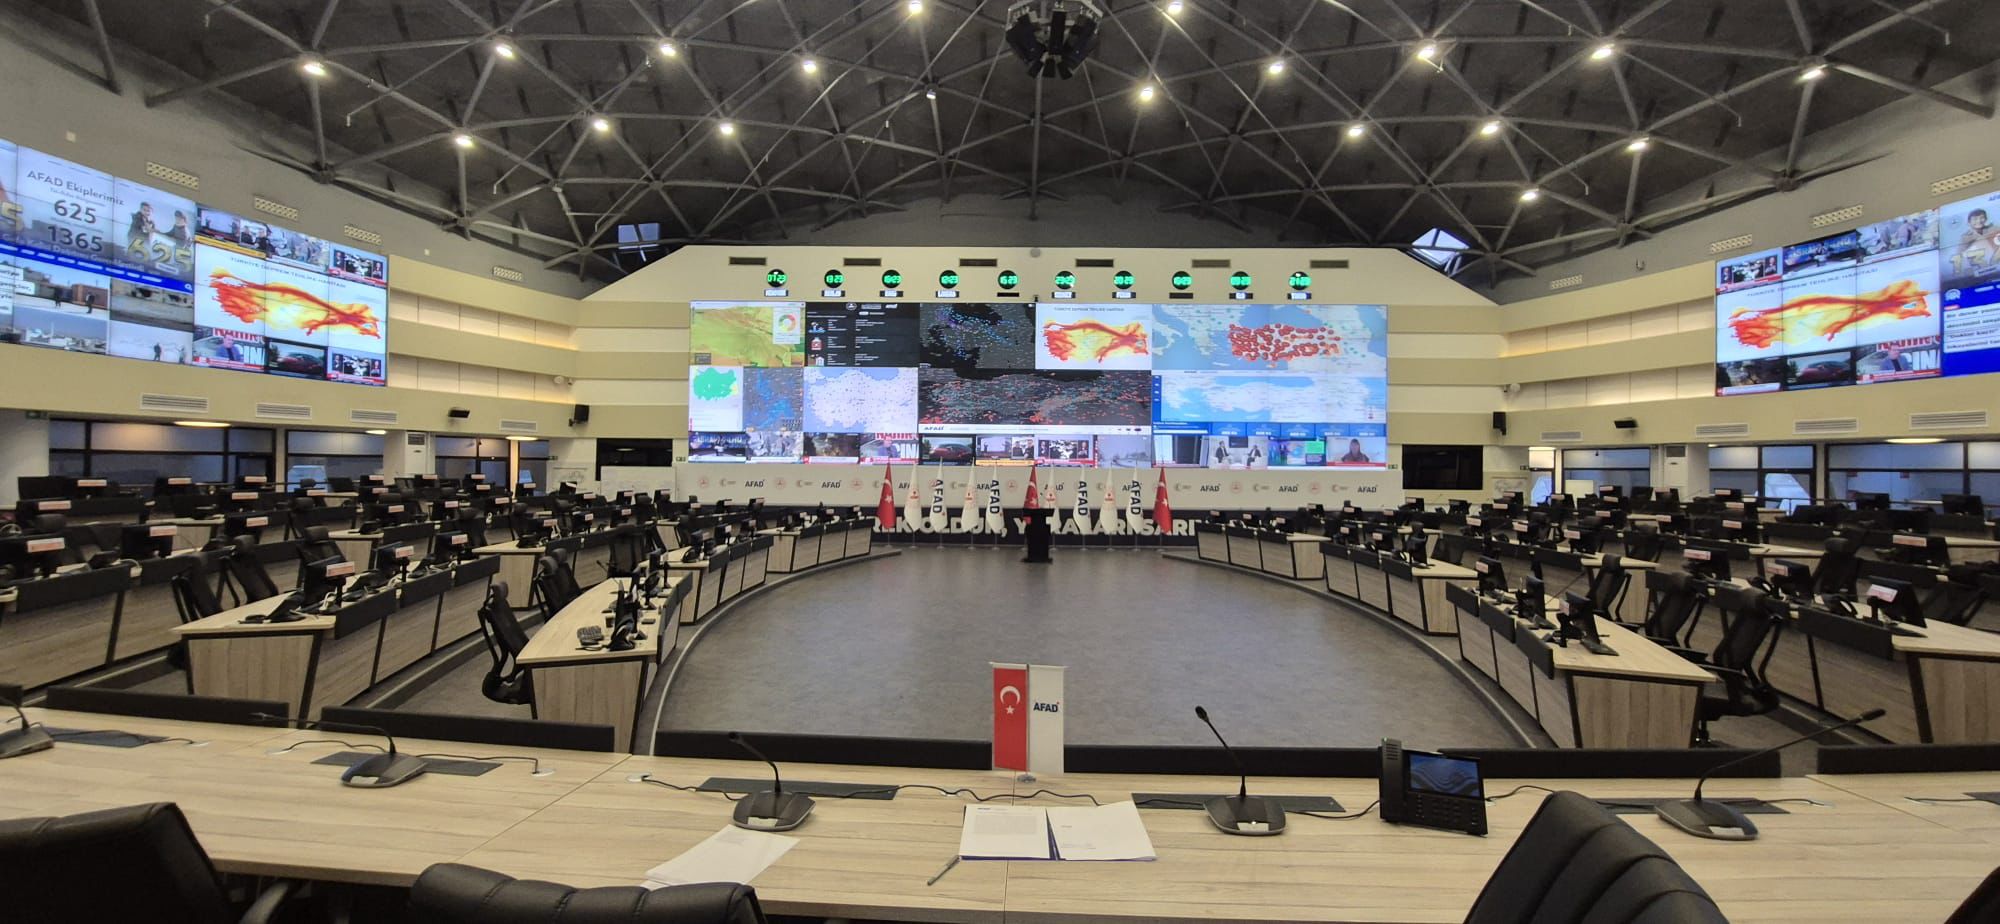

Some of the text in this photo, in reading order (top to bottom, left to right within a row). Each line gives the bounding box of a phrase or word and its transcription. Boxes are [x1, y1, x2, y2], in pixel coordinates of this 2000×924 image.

[27, 170, 63, 187] AFAD
[66, 181, 125, 206] Ekiplerimiz
[54, 199, 97, 224] 625
[47, 225, 103, 252] 1365
[821, 481, 841, 489] AFAD
[932, 479, 943, 514] AFAD
[989, 479, 1000, 514] AFAD
[1077, 481, 1088, 516] AFAD
[1130, 480, 1141, 515] AFAD
[1278, 485, 1299, 493] AFAD
[1033, 702, 1059, 713] AFAD
